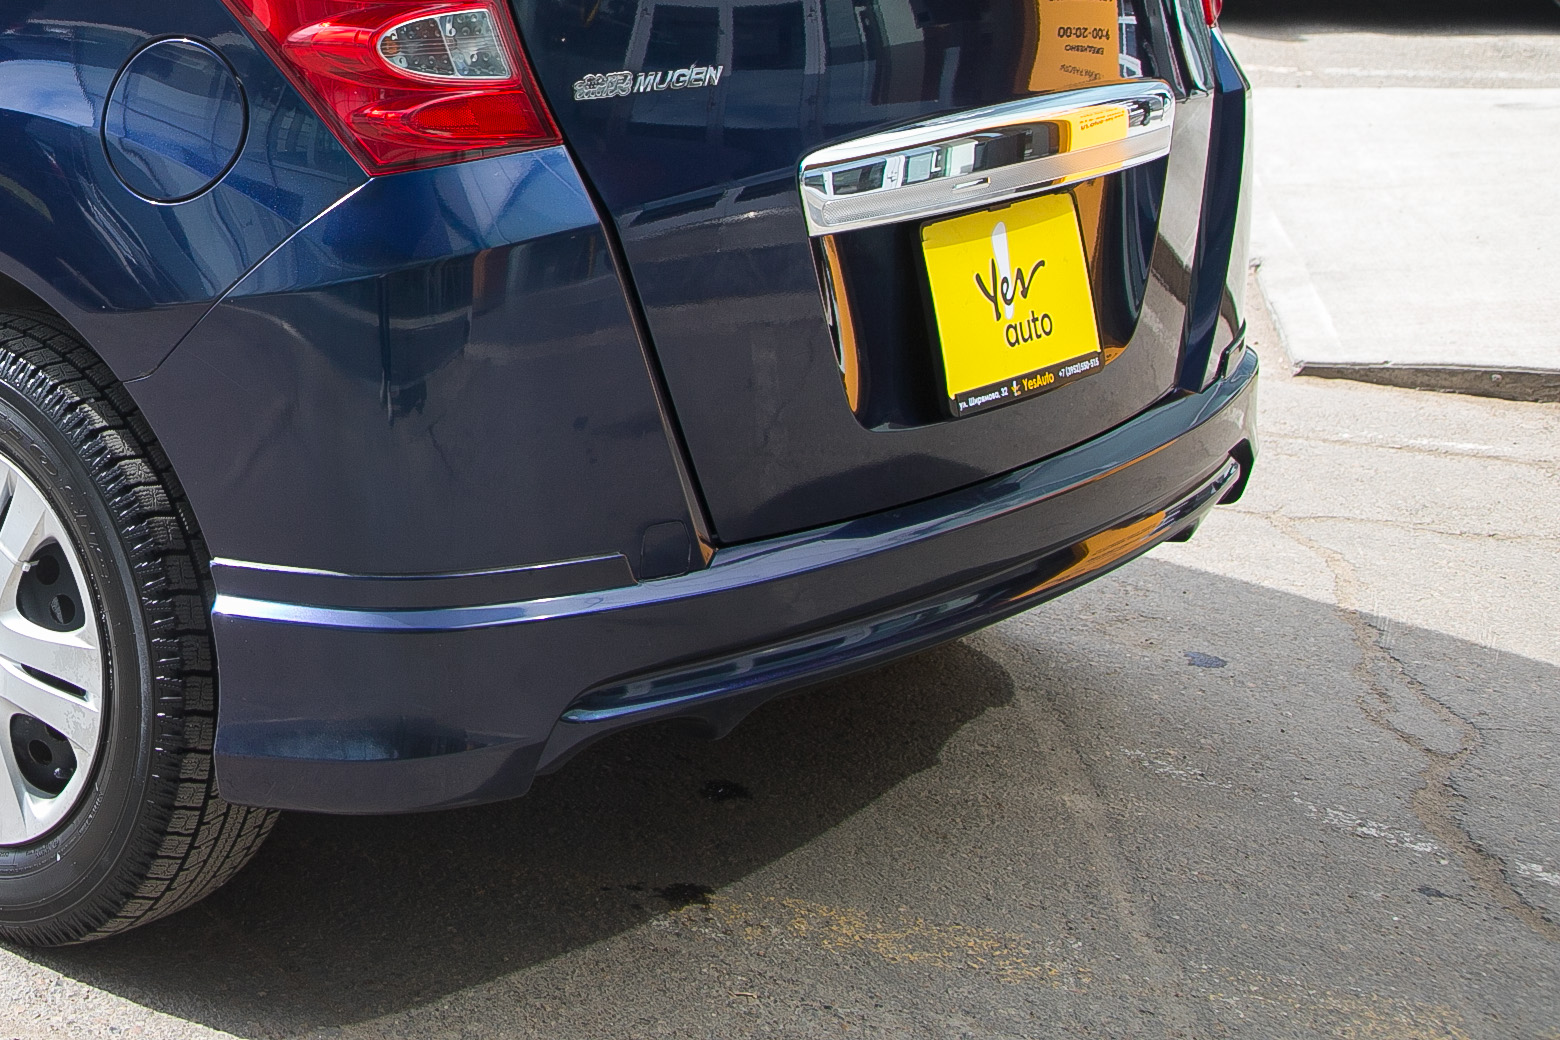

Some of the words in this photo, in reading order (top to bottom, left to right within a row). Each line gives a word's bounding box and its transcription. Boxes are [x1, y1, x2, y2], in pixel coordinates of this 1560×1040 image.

[633, 65, 724, 93] MUGEN
[1005, 310, 1053, 348] auto
[1021, 371, 1055, 391] YesAuto
